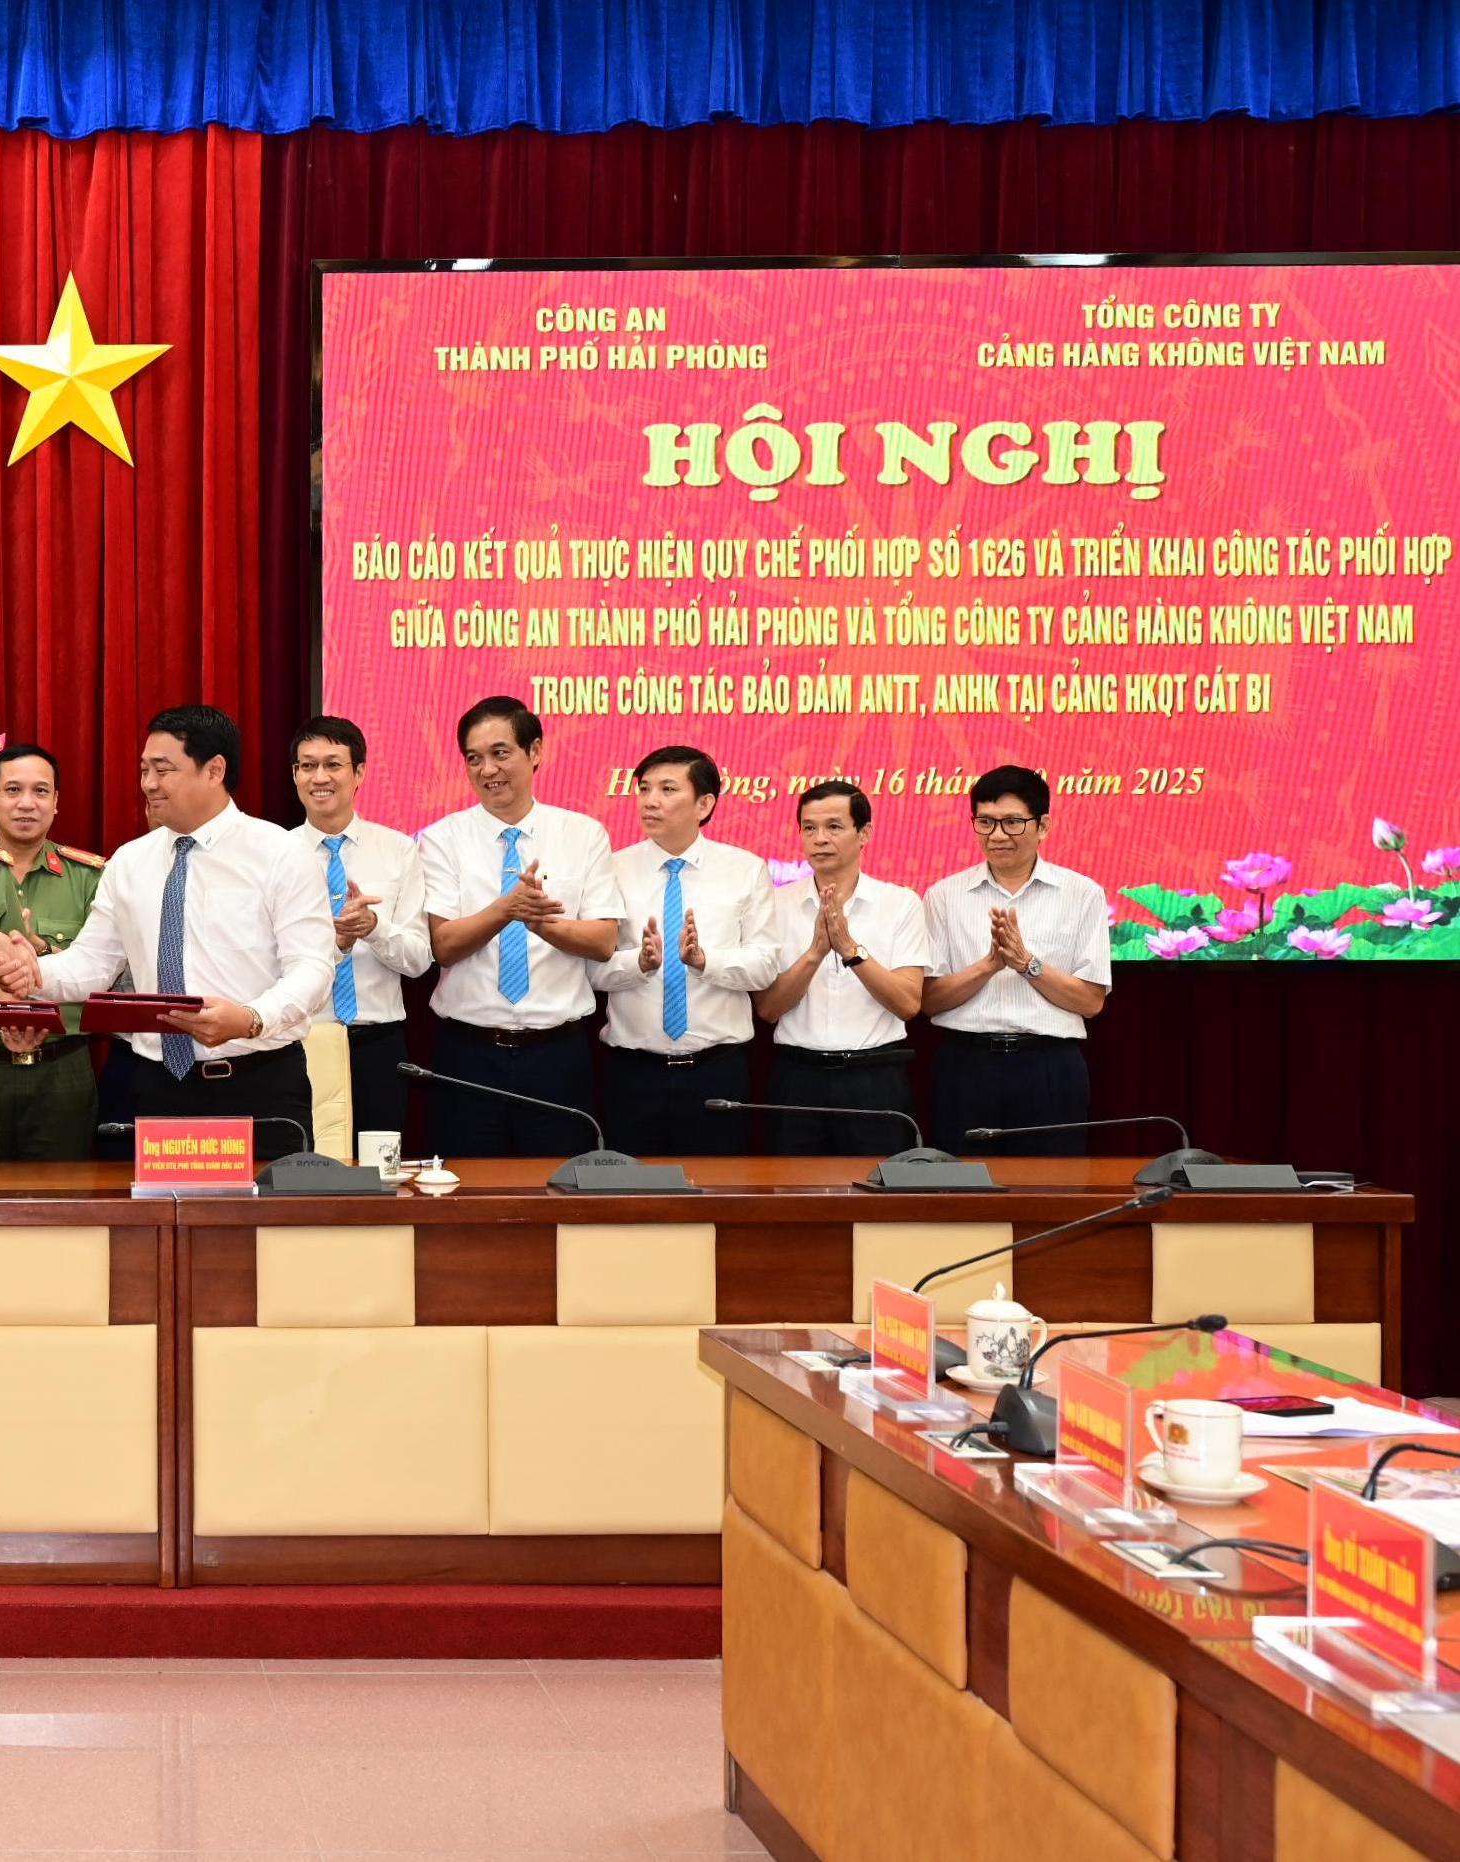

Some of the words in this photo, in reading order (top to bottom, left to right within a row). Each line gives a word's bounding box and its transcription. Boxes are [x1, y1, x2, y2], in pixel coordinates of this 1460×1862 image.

[536, 303, 616, 332] CÔNG
[625, 307, 665, 332] AN
[1082, 294, 1154, 328] TỔNG
[1164, 299, 1240, 328] CÔNG
[1250, 303, 1280, 327] TY
[434, 342, 530, 370] THÀNH
[540, 338, 598, 370] PHỐ
[608, 335, 656, 369] HẢI
[667, 340, 767, 369] PHÒNG
[978, 333, 1053, 367] CẢNG
[1063, 338, 1139, 366] HÀNG
[1149, 337, 1243, 366] KHÔNG
[1253, 337, 1311, 370] VIỆT
[1320, 341, 1384, 364] NAM
[643, 403, 845, 501] HỘI
[875, 421, 1164, 499] NGHỊ
[353, 534, 400, 580] BÁO
[409, 533, 455, 580] CÁO
[464, 527, 506, 579] KẾT
[515, 524, 562, 581] QUẢ
[569, 536, 629, 586] THỰC
[638, 531, 693, 586] HIỆN
[701, 539, 746, 579] QUY
[756, 525, 802, 578] CHẾ
[809, 524, 865, 577] PHỐI
[873, 536, 920, 585] HỢP
[928, 525, 960, 577] SỐ
[969, 538, 1025, 576] 1626
[1034, 530, 1063, 576] VÀ
[1071, 522, 1140, 576] TRIỂN
[1149, 538, 1204, 576] KHAI
[1213, 529, 1278, 576] CÔNG
[1286, 529, 1330, 576] TÁC
[1340, 522, 1395, 575] PHỐI
[1404, 534, 1451, 583] HỢP
[391, 599, 446, 647] GIỮA
[454, 601, 521, 647] CÔNG
[525, 608, 559, 646] AN
[566, 600, 645, 646] THÀNH
[653, 594, 701, 646] PHỐ
[709, 591, 748, 645] HẢI
[757, 597, 838, 645] PHÒNG
[845, 598, 876, 644] VÀ
[883, 591, 946, 645] TỔNG
[954, 598, 1019, 645] CÔNG
[1027, 607, 1054, 644] TY
[1062, 590, 1128, 644] CẢNG
[1136, 598, 1201, 644] HÀNG
[1210, 597, 1292, 644] KHÔNG
[1299, 597, 1349, 652] VIỆT
[1358, 605, 1413, 643] NAM
[531, 676, 608, 714] TRONG
[617, 667, 682, 714] CÔNG
[690, 668, 733, 714] TÁC
[742, 658, 789, 714] BẢO
[798, 658, 852, 713] ĐẢM
[860, 674, 926, 718] ANTT,
[933, 674, 999, 712] ANHK
[1007, 675, 1043, 721] TẠI
[1052, 658, 1117, 713] CẢNG
[1126, 674, 1187, 718] HKQT
[1195, 665, 1239, 712] CÁT
[1247, 674, 1270, 712] BI
[720, 768, 776, 802] òng,
[872, 769, 904, 794] 16
[915, 767, 977, 795] thán
[1057, 768, 1121, 794] năm
[1132, 768, 1203, 794] 2025
[143, 1136, 160, 1157] Ông
